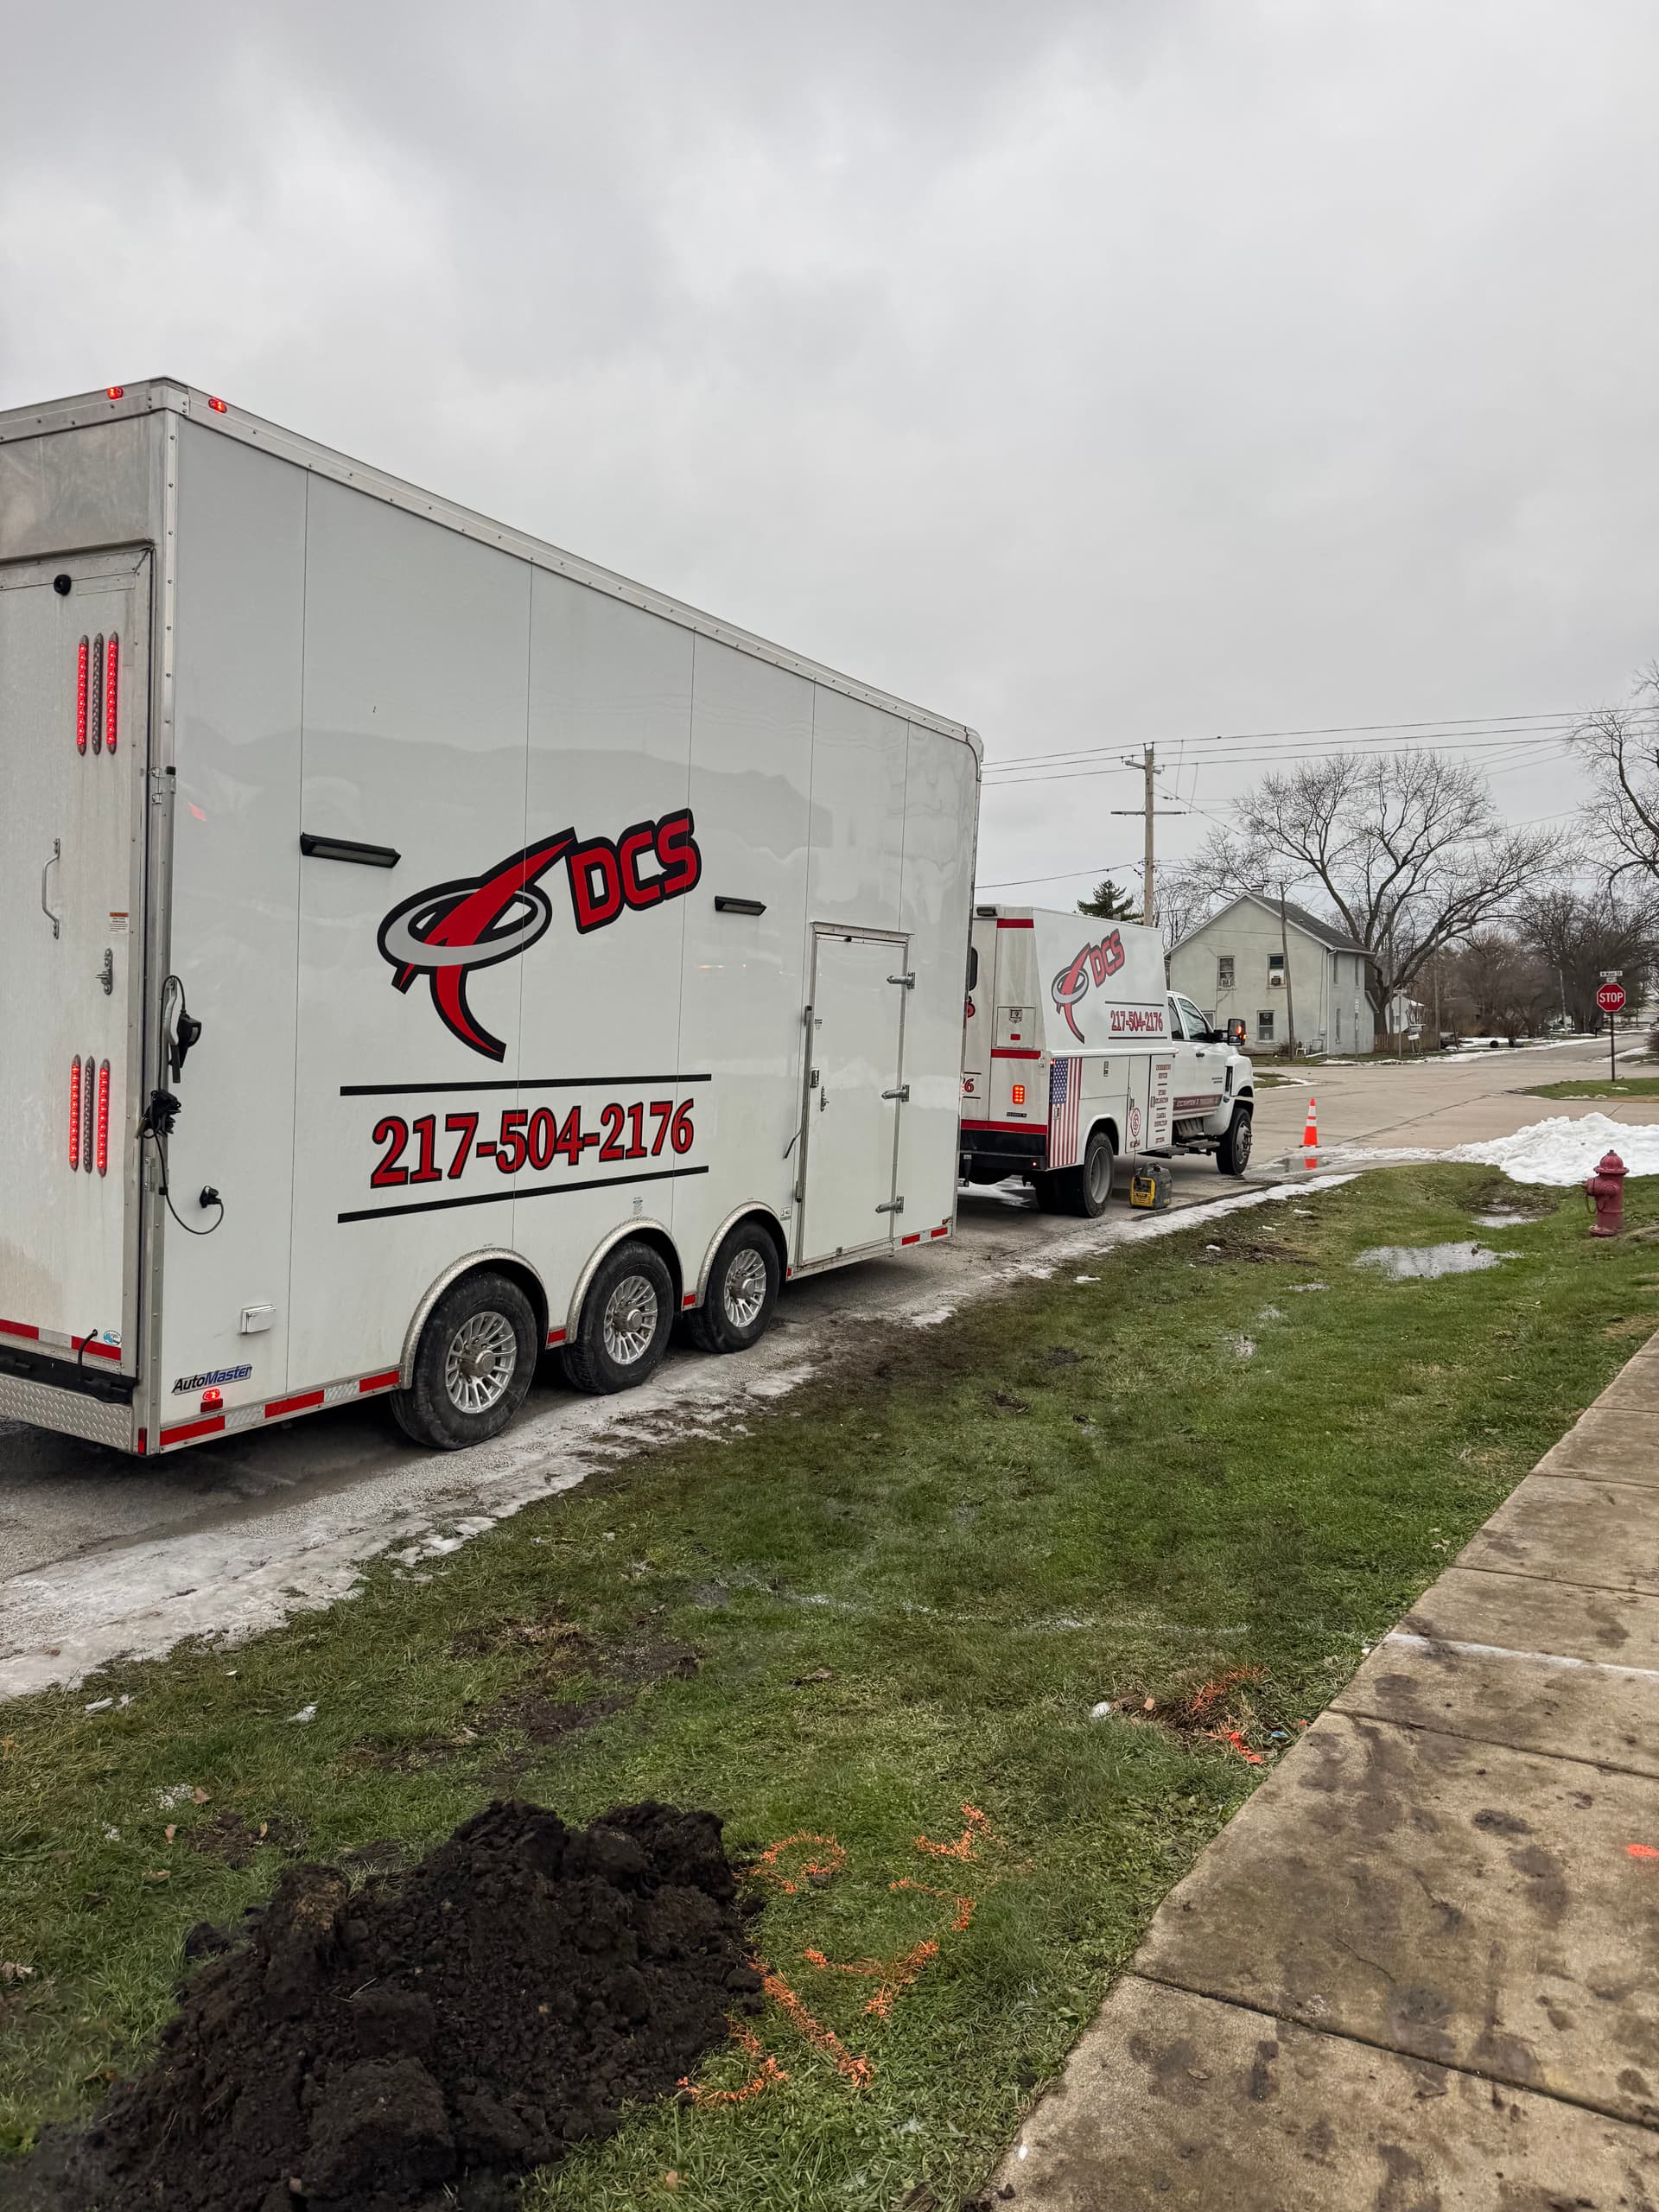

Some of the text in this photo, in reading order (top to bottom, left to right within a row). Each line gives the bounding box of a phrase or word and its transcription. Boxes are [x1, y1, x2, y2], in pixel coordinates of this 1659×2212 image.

[565, 808, 702, 934] DCS
[1090, 928, 1125, 988] DCS
[1599, 992, 1624, 1003] STOP
[1110, 1010, 1163, 1032] 217-504-2176
[371, 1098, 694, 1189] 217-504-2176
[171, 1365, 253, 1394] AutoMaster
